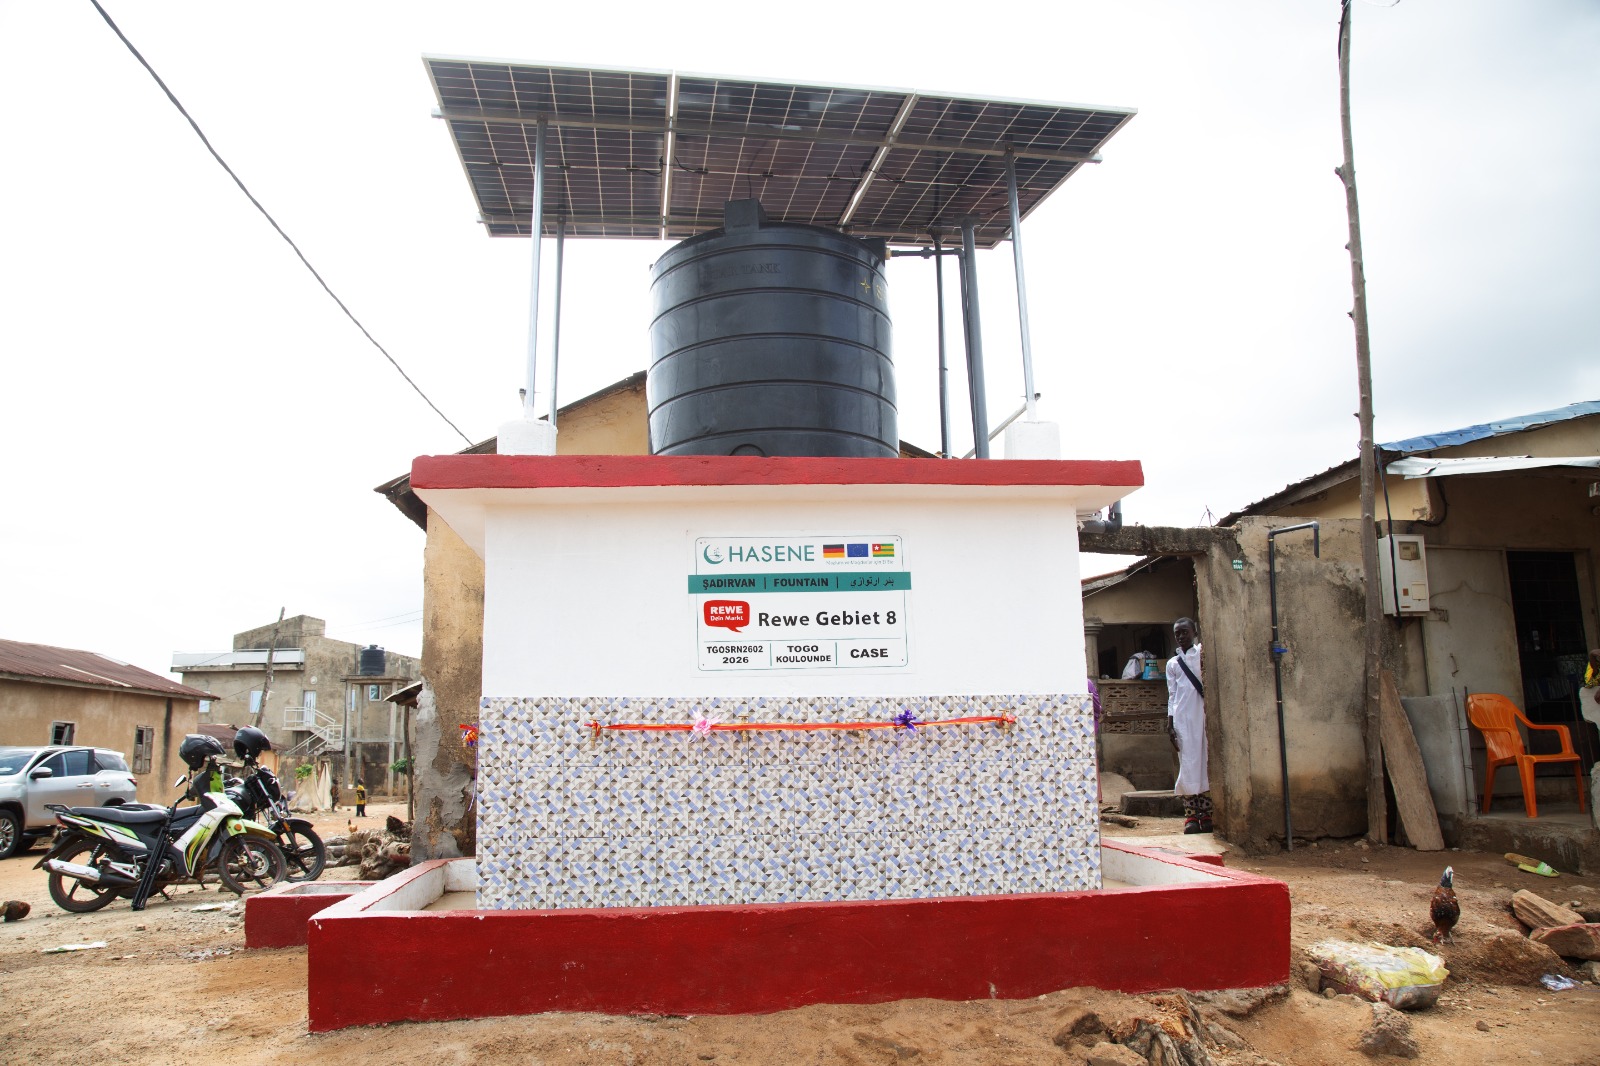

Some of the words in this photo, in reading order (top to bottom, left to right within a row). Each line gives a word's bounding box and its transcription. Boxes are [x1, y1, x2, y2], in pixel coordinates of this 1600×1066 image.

[729, 545, 814, 562] HASENE
[702, 578, 755, 590] ŞADIRVAN
[774, 578, 829, 587] FOUNTAIN
[710, 606, 743, 614] REWE
[758, 611, 809, 626] Rewe
[816, 611, 880, 626] Gebiet
[886, 611, 897, 625] 8
[850, 649, 889, 658] CASE
